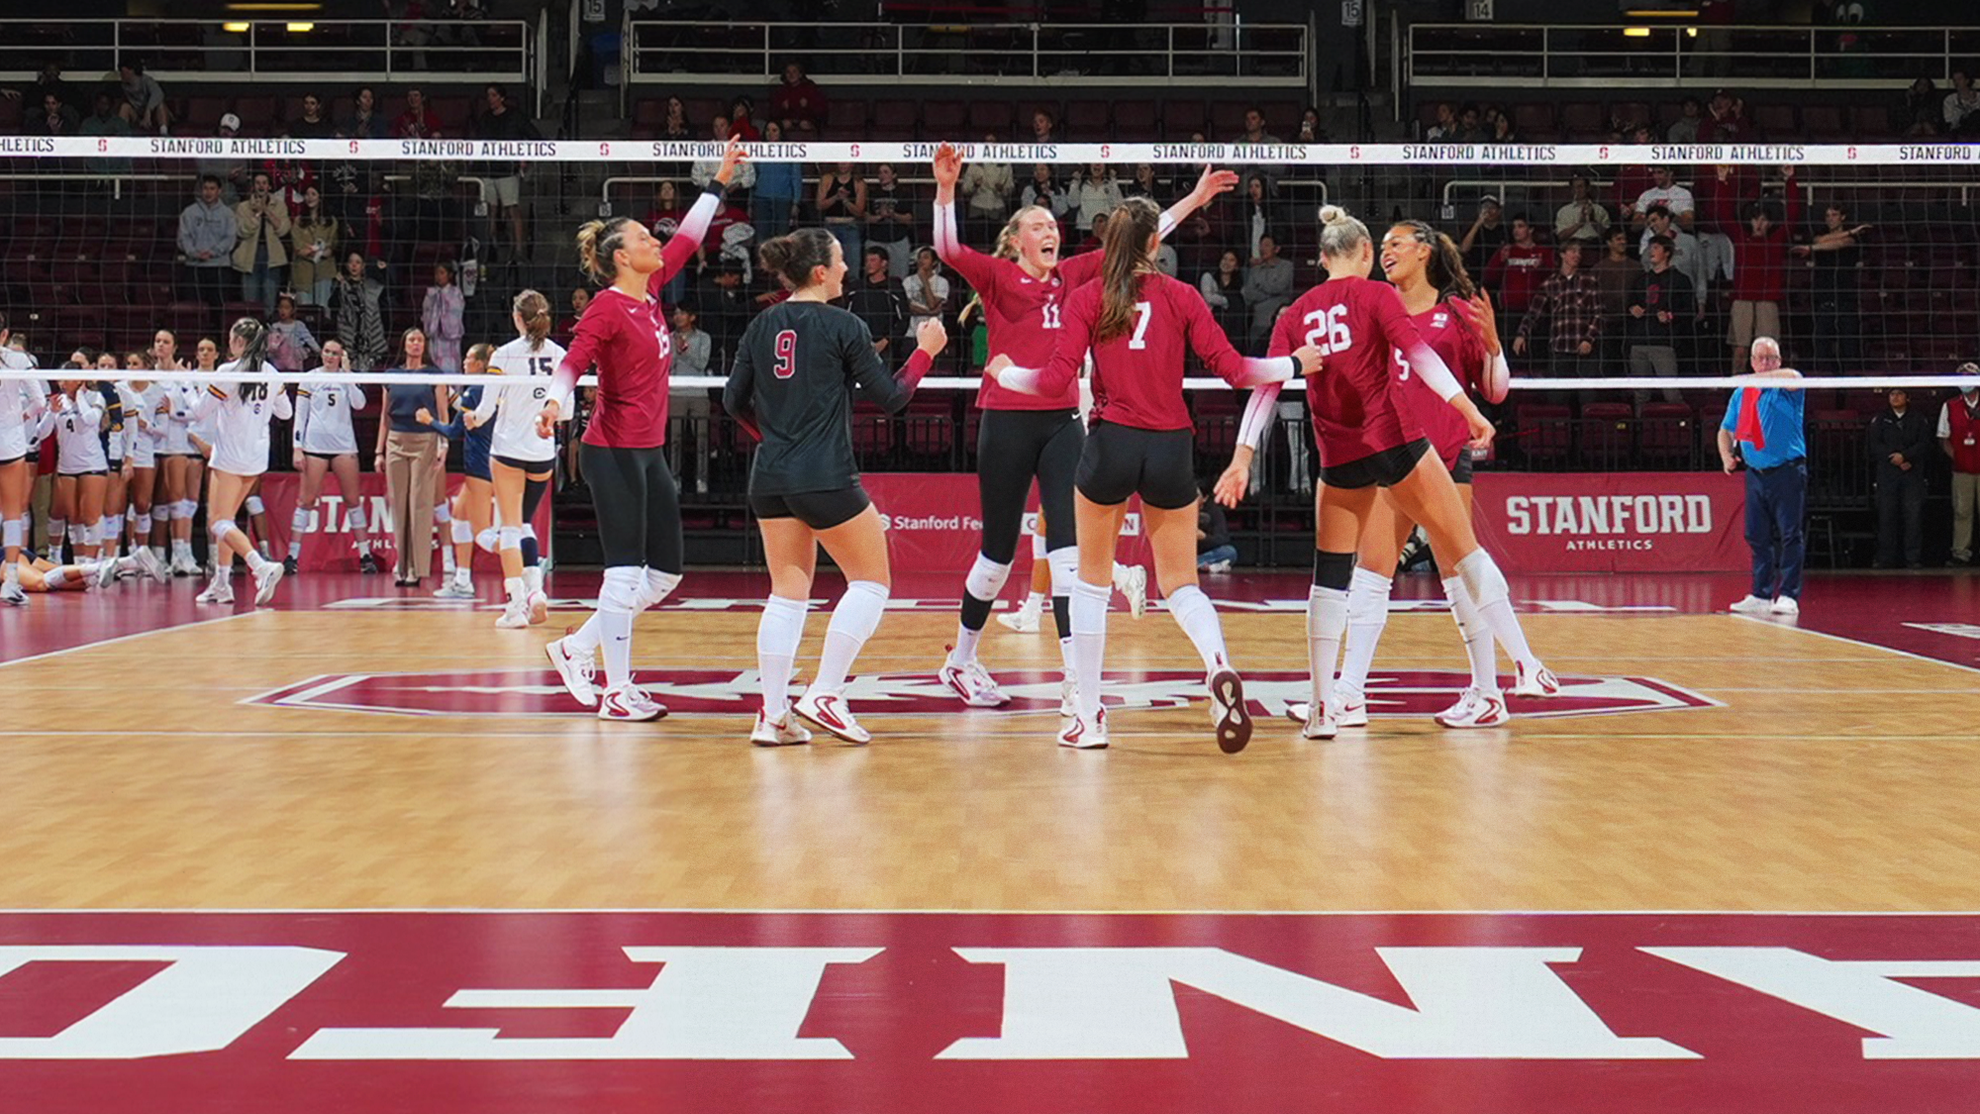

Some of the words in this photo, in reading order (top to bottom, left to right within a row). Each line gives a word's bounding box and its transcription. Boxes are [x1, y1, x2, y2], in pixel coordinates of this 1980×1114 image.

[1344, 2, 1360, 18] 15
[1474, 3, 1489, 18] 14
[151, 139, 223, 154] STANFORD
[230, 141, 306, 155] ATHLETICS
[402, 142, 474, 156] STANFORD
[481, 142, 556, 157] ATHLETICS
[652, 143, 724, 158] STANFORD
[982, 145, 1057, 159] ATHLETICS
[1153, 145, 1225, 159] STANFORD
[1232, 146, 1307, 160] ATHLETICS
[1403, 146, 1475, 160] STANFORD
[1481, 146, 1556, 160] ATHLETICS
[1651, 146, 1723, 160] STANFORD
[1730, 146, 1804, 160] ATHLETICS
[1900, 146, 1971, 160] STANFORD
[1042, 303, 1062, 329] 11
[1128, 301, 1151, 350] 7
[1303, 303, 1352, 357] 26
[773, 329, 798, 379] 9
[528, 357, 553, 376] 15
[1394, 348, 1410, 381] 5
[327, 393, 336, 407] 5
[66, 418, 75, 432] 4
[1506, 494, 1712, 534] STANFORD
[894, 516, 959, 530] Stanford
[1566, 540, 1653, 550] ATHLETICS
